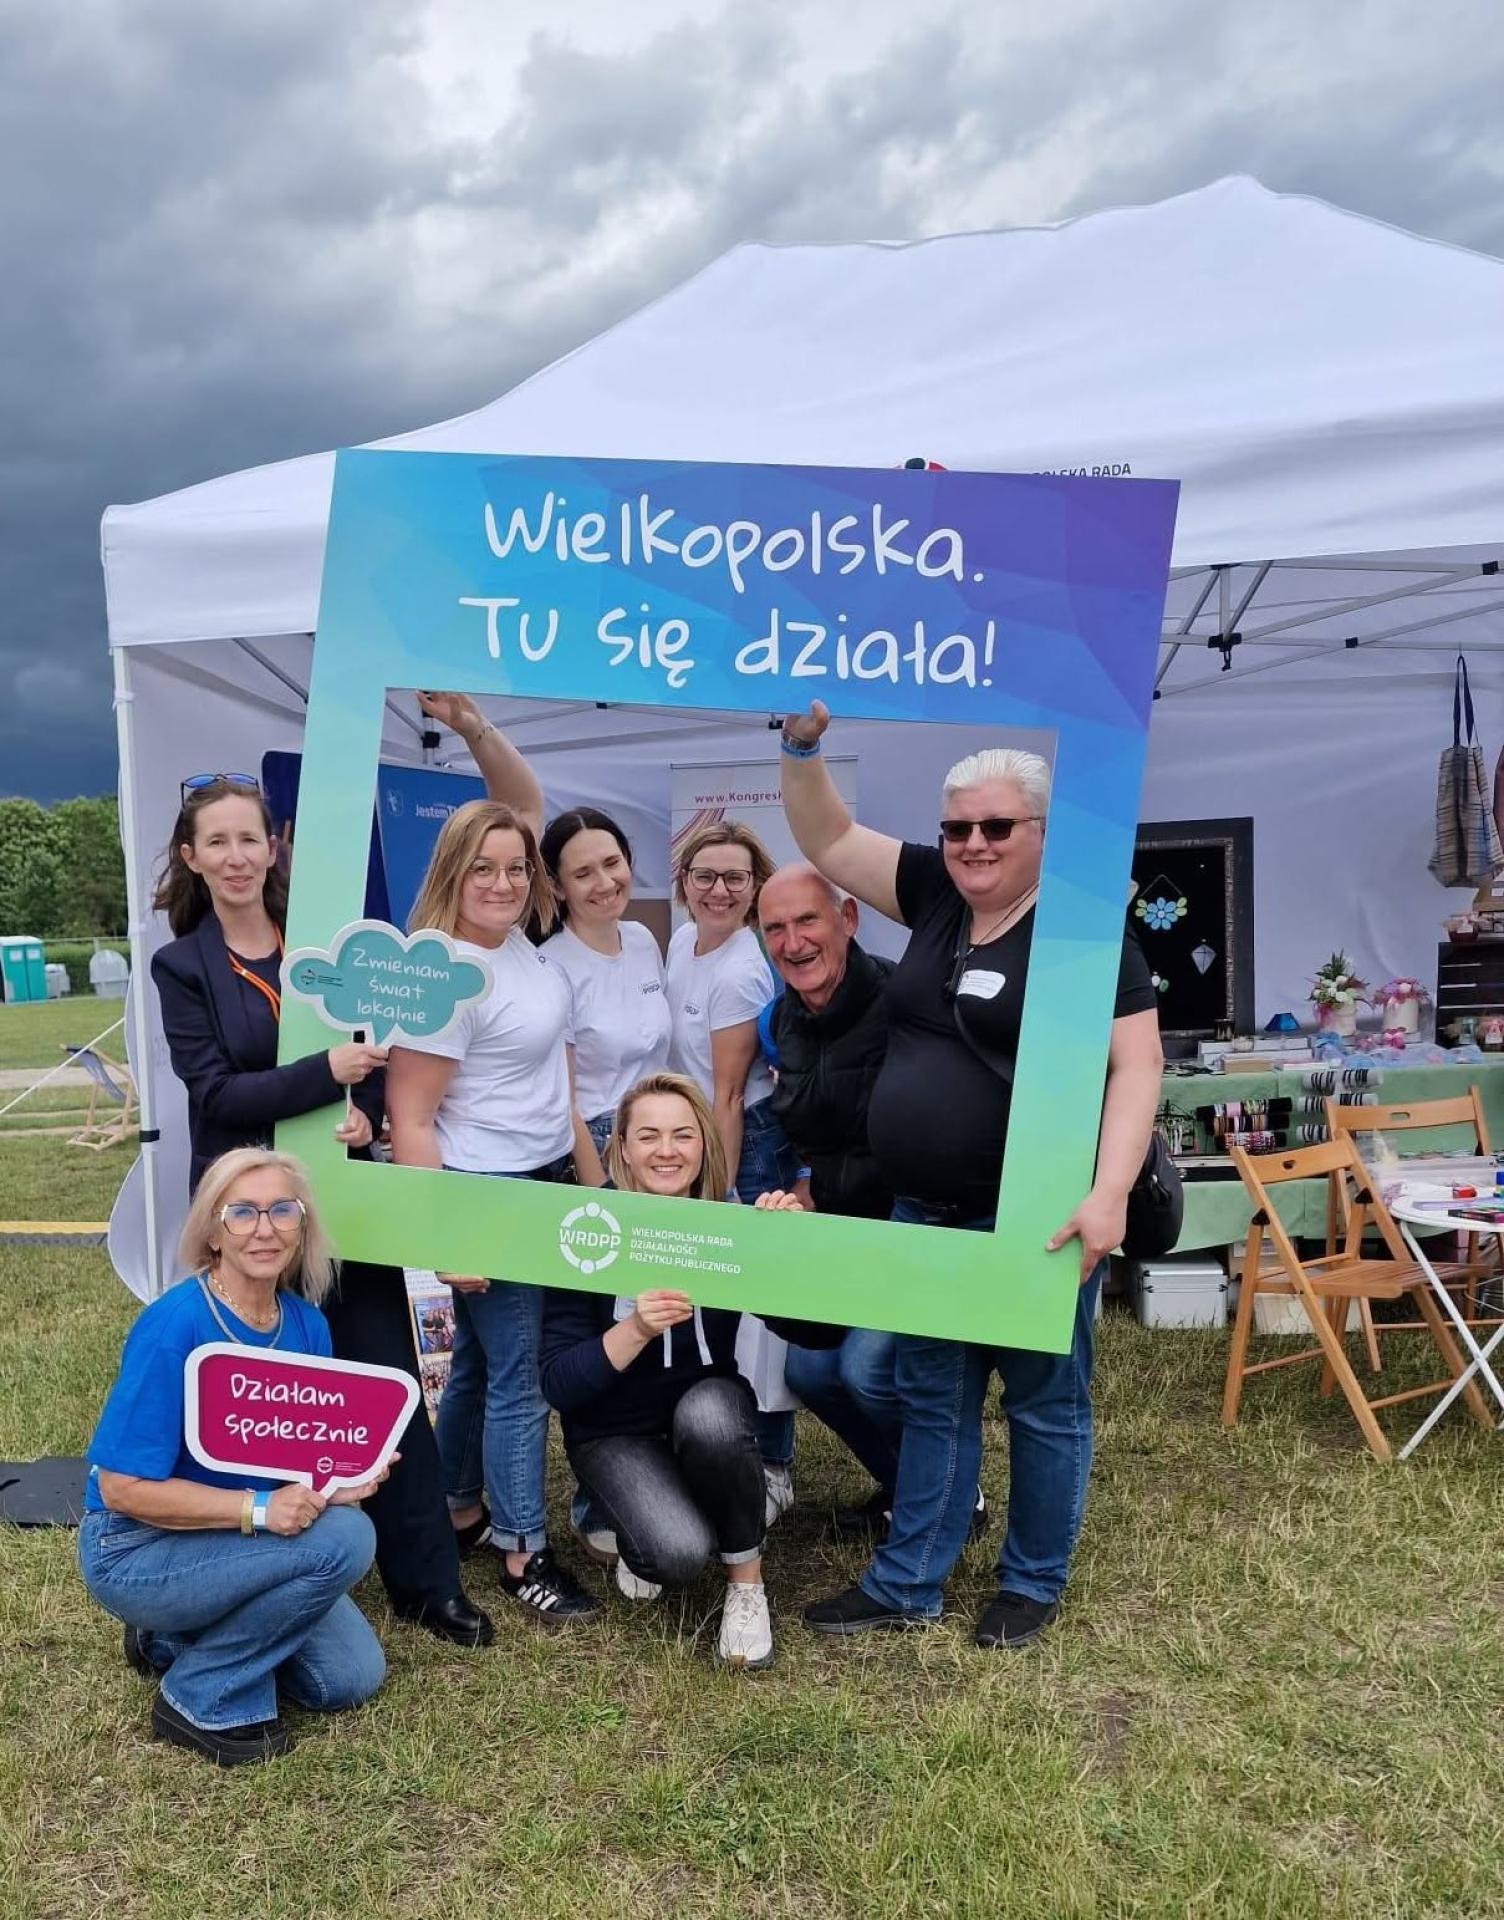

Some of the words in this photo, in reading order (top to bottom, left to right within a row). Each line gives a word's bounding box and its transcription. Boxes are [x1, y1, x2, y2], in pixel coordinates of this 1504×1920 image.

[1092, 463, 1132, 477] RADA
[484, 491, 984, 593] Wielkopolska.
[597, 602, 694, 687] się
[734, 607, 995, 688] działa!
[352, 947, 450, 982] Zmieniam
[368, 975, 425, 999] świat
[357, 999, 427, 1024] lokalnie
[559, 1228, 622, 1249] WRDPP
[631, 1227, 705, 1244] WIELKOPOLSKA
[707, 1235, 733, 1248] RADA
[674, 1257, 741, 1274] PUBLICZNEGO
[230, 1373, 345, 1407] Działam
[224, 1414, 368, 1444] społecznie
